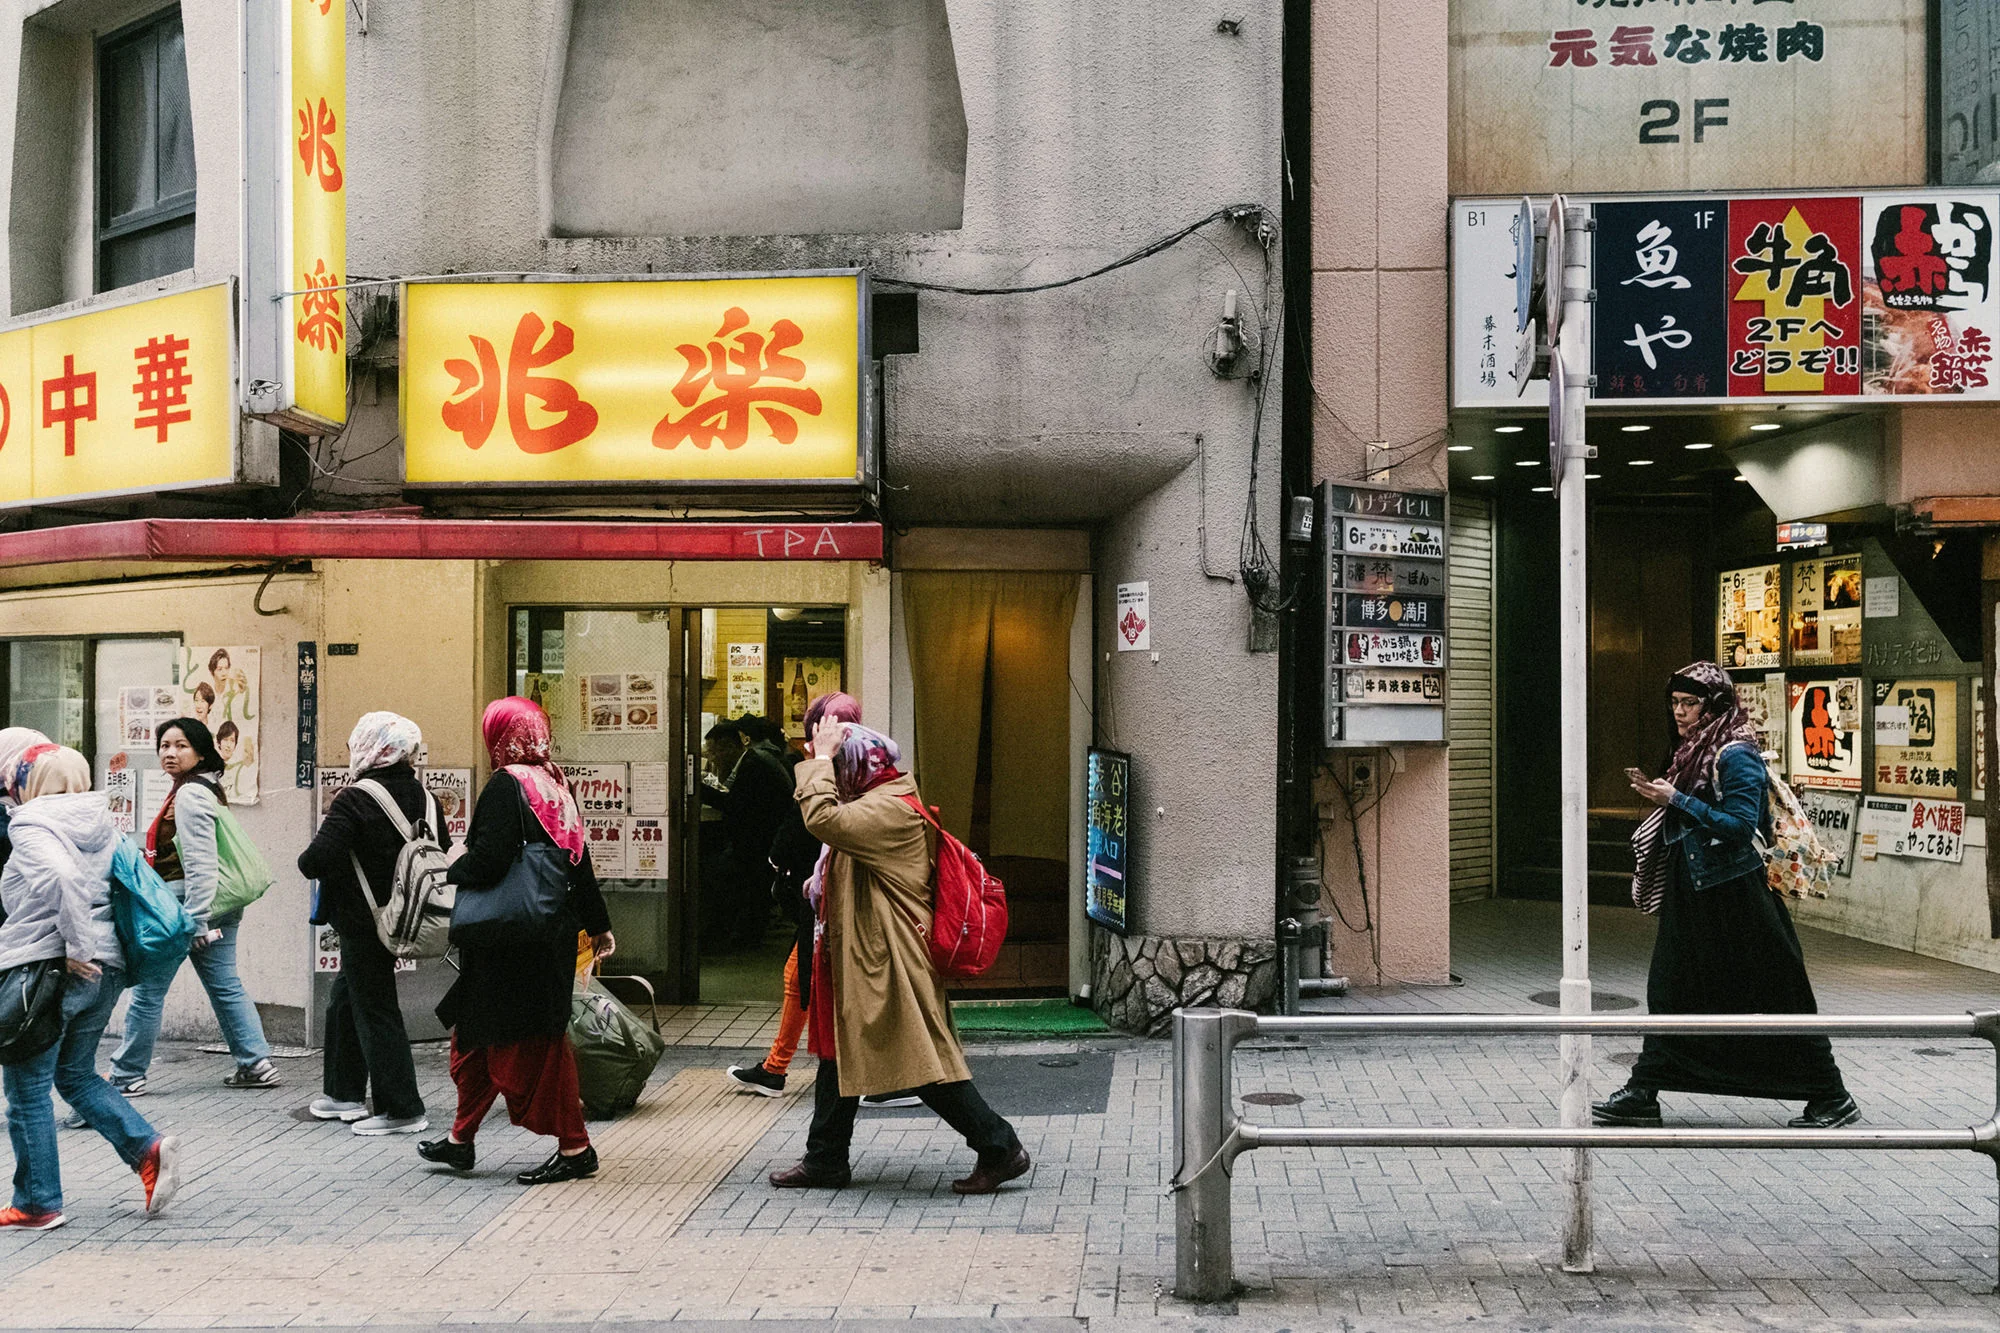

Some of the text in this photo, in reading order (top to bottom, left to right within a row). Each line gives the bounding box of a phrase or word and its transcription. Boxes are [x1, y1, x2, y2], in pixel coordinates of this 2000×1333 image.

[1549, 20, 1825, 67] 元気な焼肉
[1639, 98, 1730, 144] 2F
[298, 97, 344, 354] 兆楽
[1468, 212, 1486, 226] B1
[1694, 211, 1715, 229] 1F
[1733, 222, 1852, 307] 牛角
[1620, 219, 1692, 370] 魚や
[1747, 318, 1843, 343] 2Fへ
[1930, 318, 1951, 350] 名物
[1481, 316, 1497, 387] 幕末酒場
[442, 306, 823, 454] 兆楽
[42, 334, 192, 457] 中華
[742, 526, 841, 557] TPA
[1349, 527, 1366, 545] 6F
[1400, 542, 1442, 556] KANATA
[1371, 562, 1393, 585] 梵
[1733, 573, 1745, 588] 6F
[1797, 562, 1816, 594] 梵
[1361, 600, 1427, 622] 博多 満月
[1365, 679, 1422, 693] 牛角渋谷店
[1792, 684, 1803, 697] 3F
[1876, 683, 1890, 697] 2F
[299, 763, 311, 778] 31
[560, 766, 599, 777] 店のメニュー
[1878, 765, 1957, 788] 元気な焼肉
[583, 800, 624, 810] できます
[586, 820, 614, 828] アルバイト
[1911, 802, 1963, 836] 食べ放題
[632, 828, 663, 841] 大募集
[1907, 831, 1960, 856] やってるよ!
[320, 956, 342, 969] 93
